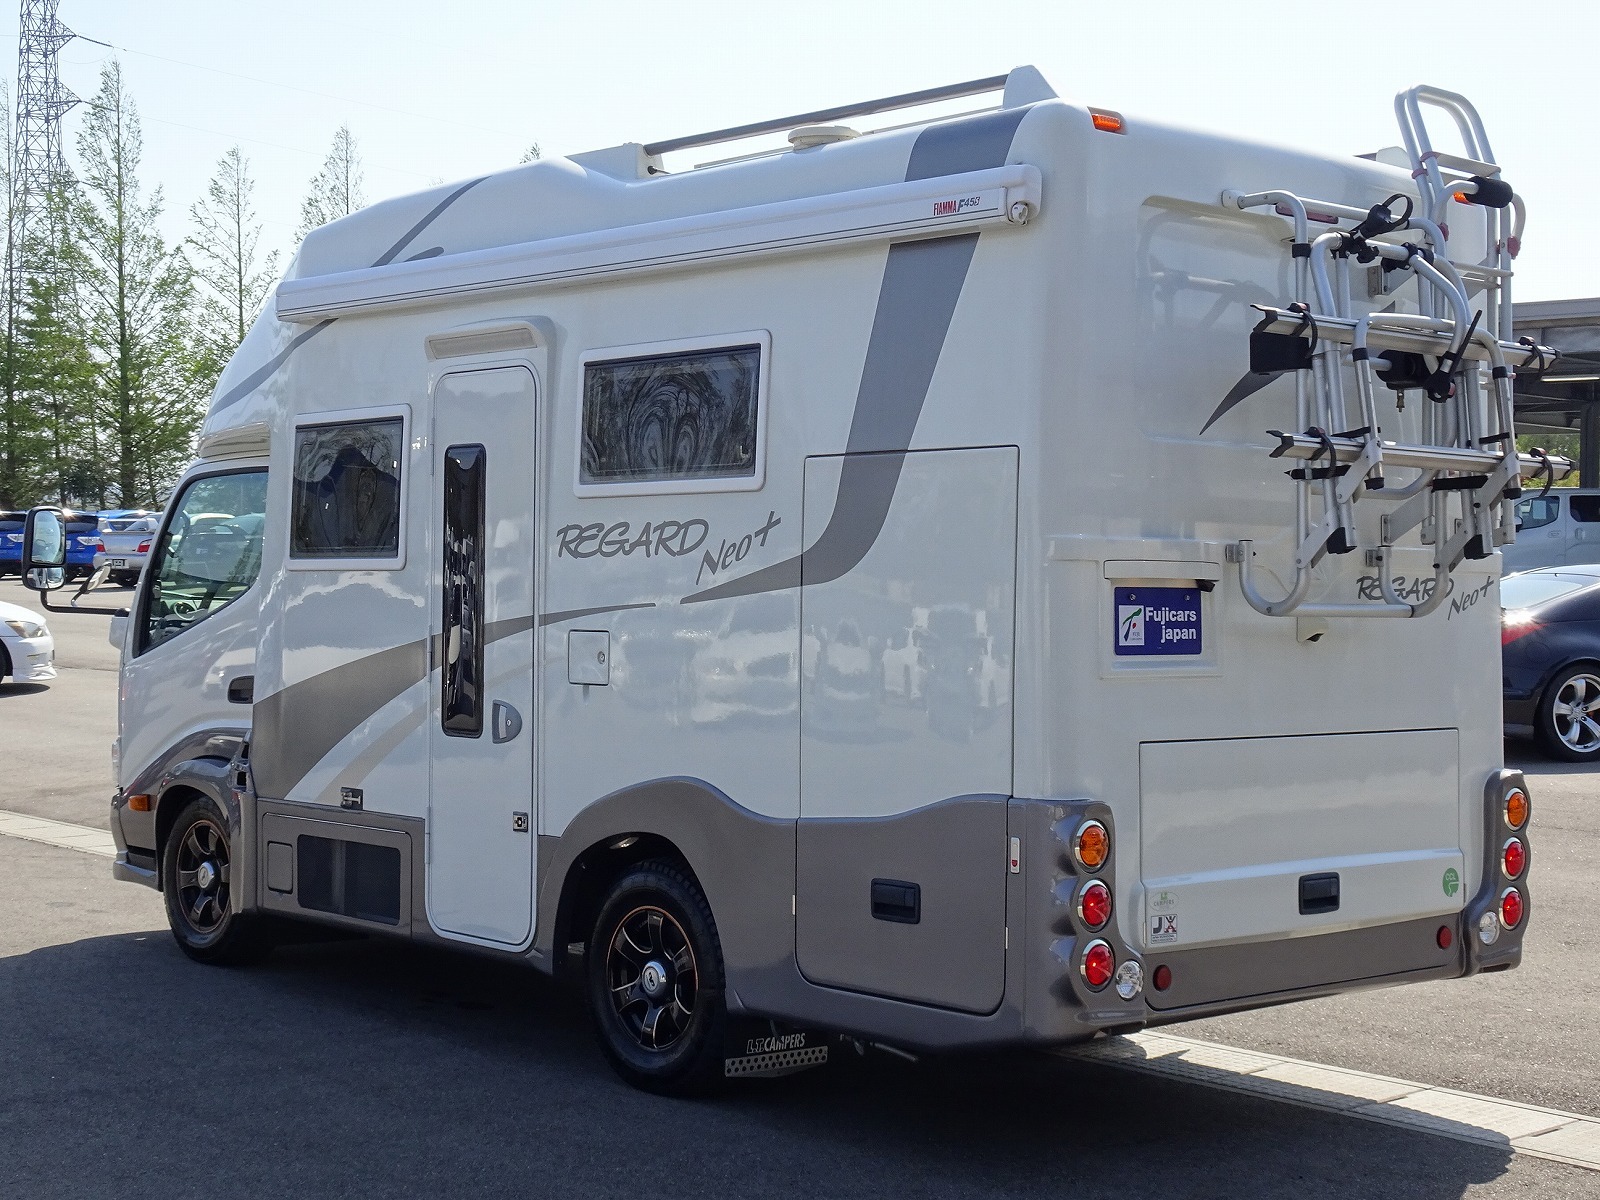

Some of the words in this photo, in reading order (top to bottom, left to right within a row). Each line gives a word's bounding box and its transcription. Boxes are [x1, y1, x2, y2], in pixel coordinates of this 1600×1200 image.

[933, 200, 957, 216] FIAMMA
[556, 518, 710, 560] REGARD
[1145, 606, 1197, 625] Fujicars
[1160, 625, 1197, 643] japan
